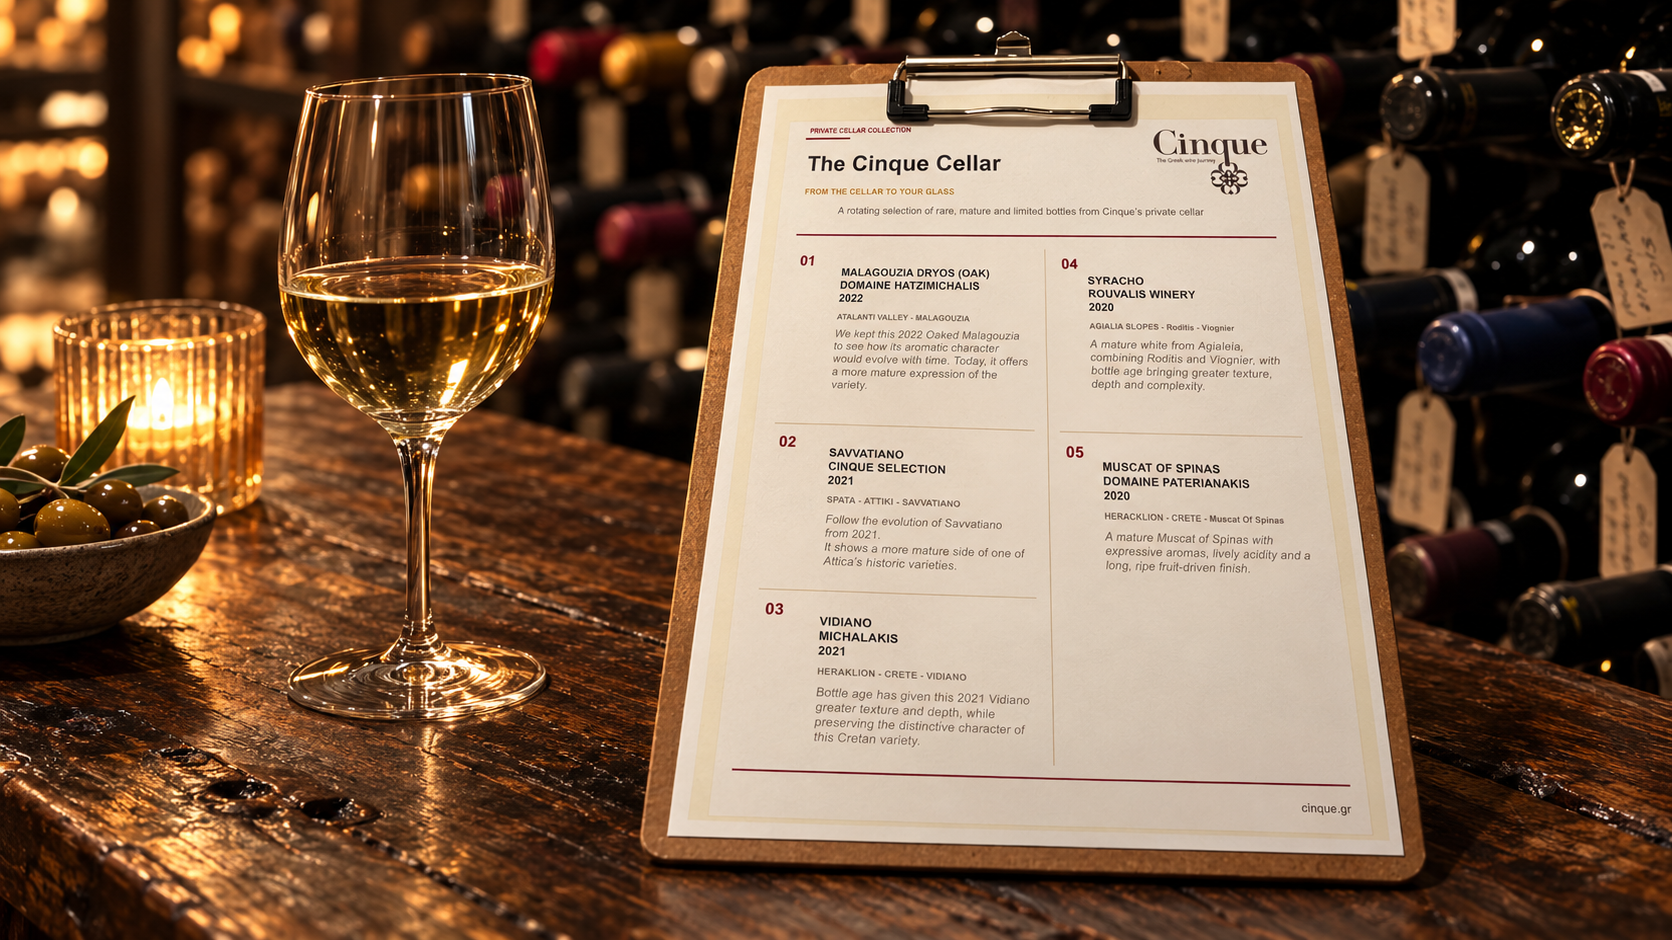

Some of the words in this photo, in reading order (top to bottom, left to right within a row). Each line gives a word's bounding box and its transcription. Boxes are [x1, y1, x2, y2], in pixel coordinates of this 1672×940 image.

[1153, 129, 1268, 167] Cinque
[808, 155, 845, 171] The
[852, 155, 928, 175] Cinque
[936, 154, 1001, 171] Cellar
[837, 206, 844, 214] A
[846, 206, 879, 216] rotating
[882, 206, 922, 214] selection
[924, 206, 933, 214] of
[959, 207, 991, 215] mature
[993, 207, 1010, 215] and
[1013, 206, 1043, 215] limited
[1046, 207, 1076, 215] bottles
[1078, 207, 1099, 215] from
[1102, 207, 1142, 217] Cinque's
[1145, 207, 1176, 217] private
[1179, 207, 1204, 216] cellar
[800, 255, 814, 265] 01
[1061, 258, 1078, 269] 04
[841, 267, 913, 276] MALAGOUZIA
[917, 268, 954, 277] DRYOS
[958, 269, 989, 279] (OAK)
[840, 280, 890, 289] DOMAINE
[894, 281, 979, 290] HATZIMICHALIS
[1087, 276, 1144, 285] SYRACHO
[838, 293, 863, 302] 2022
[1088, 289, 1146, 298] ROUVALIS
[1149, 289, 1195, 299] WINERY
[1088, 302, 1113, 311] 2020
[915, 314, 970, 322] MALAGOUZIA
[1125, 322, 1159, 330] SLOPES
[1166, 323, 1194, 331] Roditis
[835, 329, 850, 338] We
[853, 329, 875, 340] kept
[877, 329, 895, 338] this
[897, 329, 922, 339] 2022
[925, 330, 959, 339] Oaked
[961, 330, 1019, 342] Malagouzia
[1089, 339, 1097, 348] A
[1101, 340, 1137, 349] mature
[1140, 340, 1167, 349] white
[1171, 340, 1194, 350] from
[833, 354, 862, 363] would
[865, 355, 898, 364] evolve
[901, 355, 921, 364] with
[925, 355, 949, 364] time.
[954, 355, 986, 367] Today,
[990, 356, 996, 365] it
[999, 356, 1028, 366] offers
[1090, 352, 1143, 364] combining
[1147, 353, 1183, 363] Roditis
[1186, 355, 1205, 363] and
[1259, 356, 1280, 365] with
[1123, 368, 1142, 378] age
[1146, 366, 1188, 379] bringing
[1191, 369, 1229, 379] greater
[1232, 369, 1271, 379] texture,
[1091, 379, 1120, 390] depth
[1124, 380, 1144, 389] and
[1146, 380, 1205, 392] complexity.
[779, 435, 796, 447] 02
[829, 447, 903, 459] SAVVATIANO
[1066, 445, 1083, 458] 05
[828, 461, 873, 471] CINQUE
[877, 463, 945, 474] SELECTION
[1102, 461, 1152, 472] MUSCAT
[1156, 463, 1172, 472] OF
[1175, 463, 1220, 473] SPINAS
[827, 475, 852, 485] 2021
[1103, 476, 1159, 486] DOMAINE
[1162, 477, 1249, 488] PATERIANAKIS
[826, 495, 855, 503] SPATA
[863, 497, 893, 505] ATTIKI
[902, 498, 960, 507] SAVVATIANO
[1103, 490, 1130, 500] 2020
[825, 514, 859, 524] Follow
[862, 515, 878, 525] the
[881, 517, 928, 527] evolution
[931, 517, 942, 527] of
[944, 518, 1002, 529] Savvatiano
[1104, 512, 1163, 521] HERACKLION
[1171, 513, 1201, 522] CRETE
[1209, 514, 1240, 523] Muscat
[1255, 515, 1284, 525] Spinas
[824, 528, 848, 538] from
[851, 529, 880, 539] 2021.
[1104, 531, 1113, 541] A
[1116, 533, 1153, 542] mature
[1156, 532, 1195, 543] Muscat
[1198, 533, 1209, 543] of
[1212, 534, 1248, 546] Spinas
[1252, 535, 1273, 544] with
[1105, 546, 1162, 557] expressive
[1165, 549, 1208, 559] aromas,
[1212, 548, 1240, 561] lively
[1243, 549, 1277, 562] acidity
[1280, 550, 1301, 560] and
[1303, 552, 1310, 560] a
[822, 556, 862, 566] Attica's
[865, 557, 905, 568] historic
[908, 559, 956, 570] varieties.
[1105, 560, 1131, 572] long,
[1135, 561, 1155, 572] ripe
[1159, 561, 1215, 572] fruit-driven
[1219, 562, 1250, 573] finish.
[765, 602, 783, 615] 03
[819, 616, 871, 627] VIDIANO
[819, 630, 898, 643] MICHALAKIS
[818, 645, 844, 656] 2021
[817, 667, 875, 677] HERAKLION
[884, 670, 917, 679] CRETE
[926, 672, 966, 681] VIDIANO
[816, 686, 848, 698] Bottle
[851, 690, 872, 701] age
[876, 689, 897, 700] has
[900, 690, 930, 702] given
[934, 692, 953, 702] this
[957, 692, 983, 703] 2021
[988, 694, 1030, 705] Vidiano
[815, 703, 856, 713] greater
[860, 704, 899, 715] texture
[902, 706, 924, 715] and
[927, 707, 962, 719] depth,
[966, 708, 995, 718] while
[813, 718, 874, 731] preserving
[877, 719, 895, 729] the
[898, 720, 955, 732] distinctive
[958, 722, 1011, 734] character
[1014, 724, 1025, 734] of
[1301, 803, 1351, 816] cinque.gr
